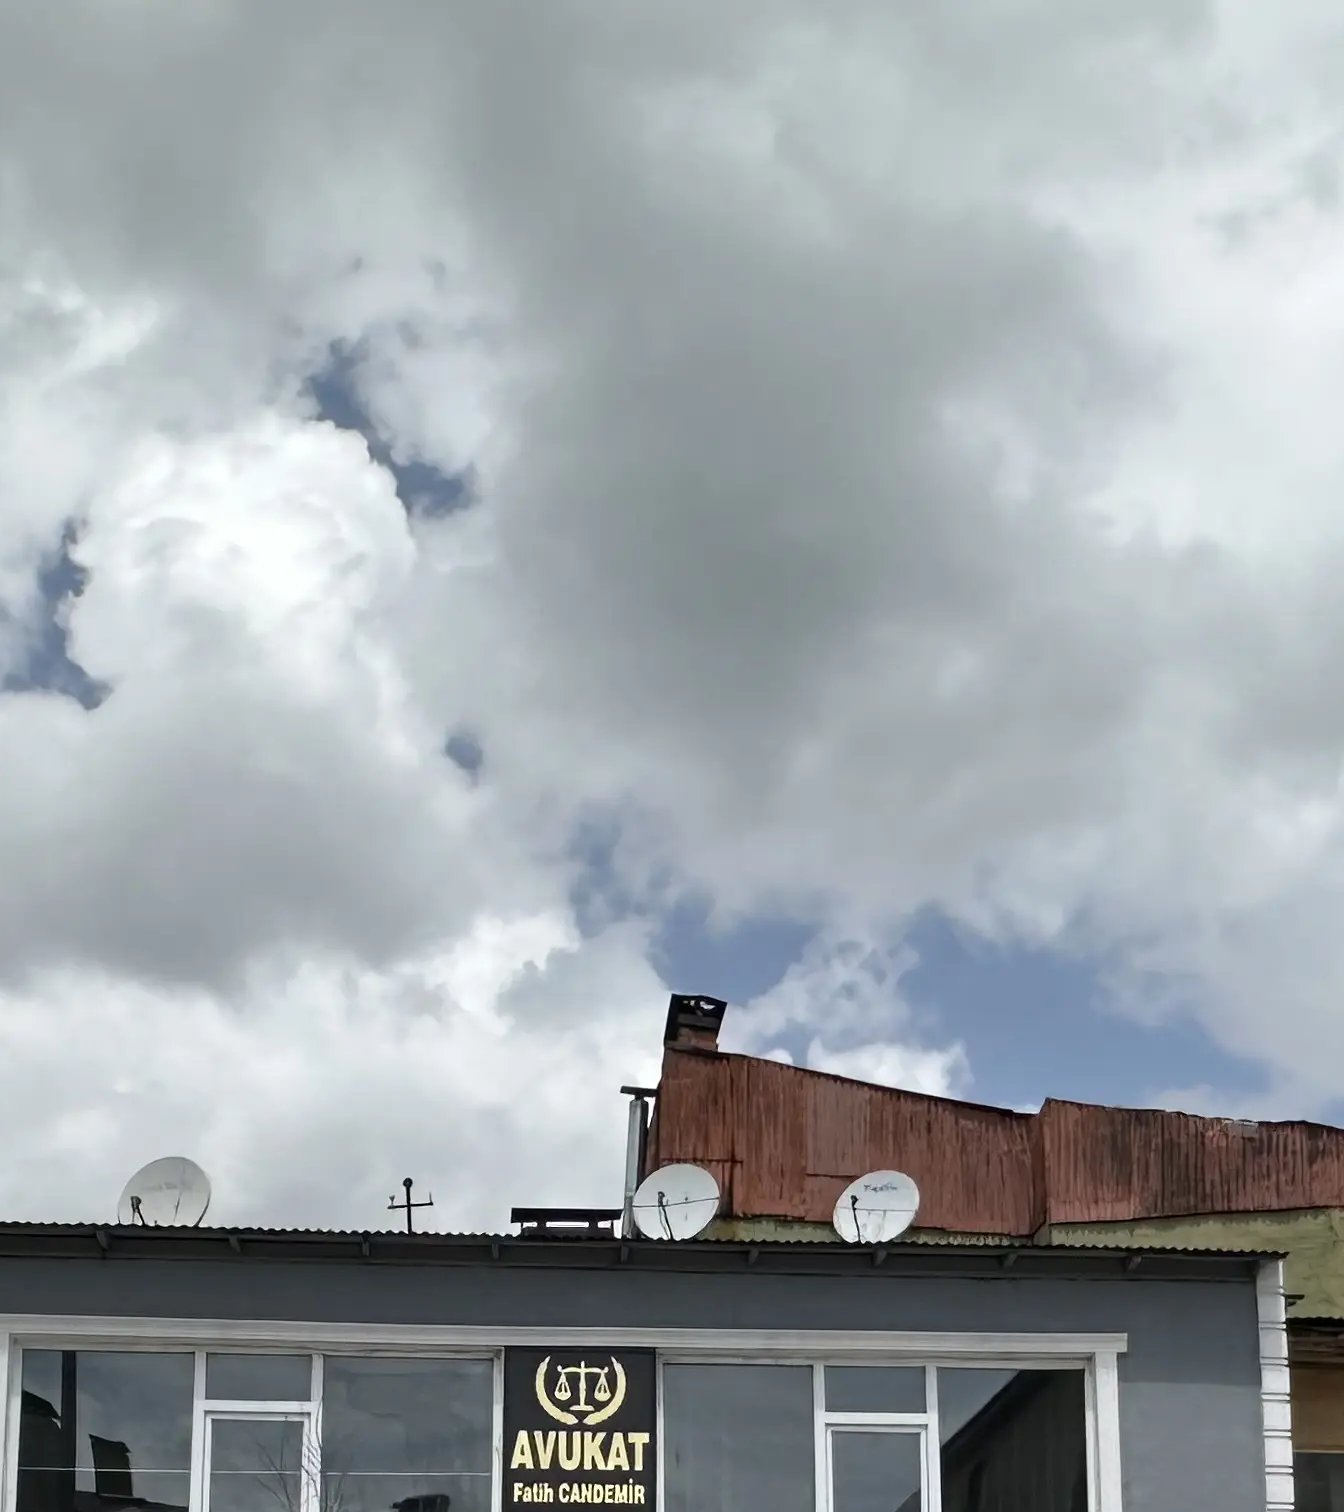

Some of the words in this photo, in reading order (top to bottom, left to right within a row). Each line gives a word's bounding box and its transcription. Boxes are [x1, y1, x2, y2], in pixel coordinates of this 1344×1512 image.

[510, 1430, 650, 1471] AVUKAT
[513, 1482, 554, 1503] Fatih
[558, 1478, 645, 1505] CANDEMİR
